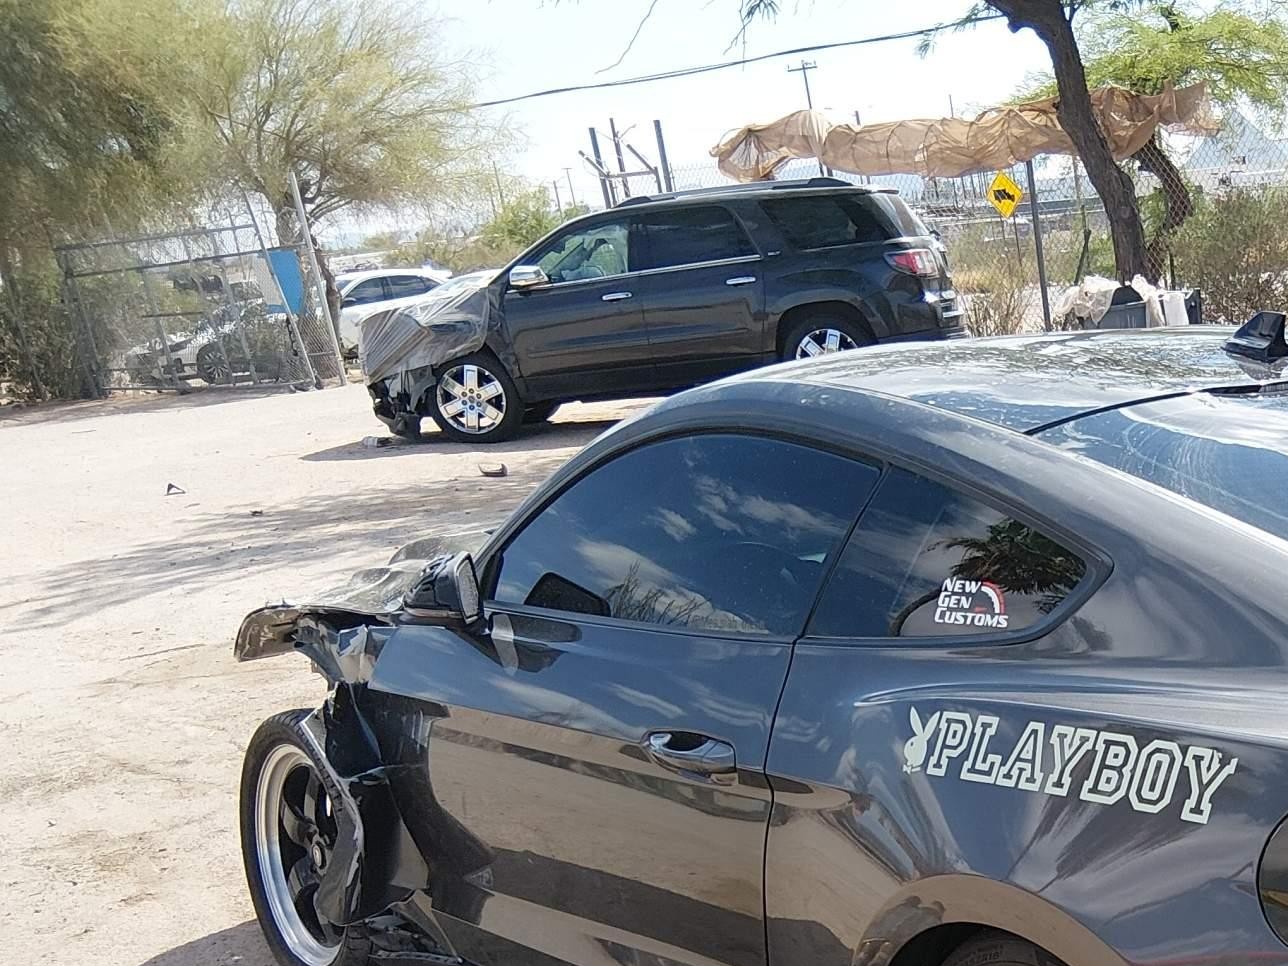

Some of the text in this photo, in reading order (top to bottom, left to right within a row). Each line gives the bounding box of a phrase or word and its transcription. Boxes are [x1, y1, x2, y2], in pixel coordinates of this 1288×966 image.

[941, 577, 981, 593] NEW
[937, 592, 972, 608] GEN
[934, 607, 1009, 628] CUSTOMS
[926, 711, 1239, 825] PLAYBOY
